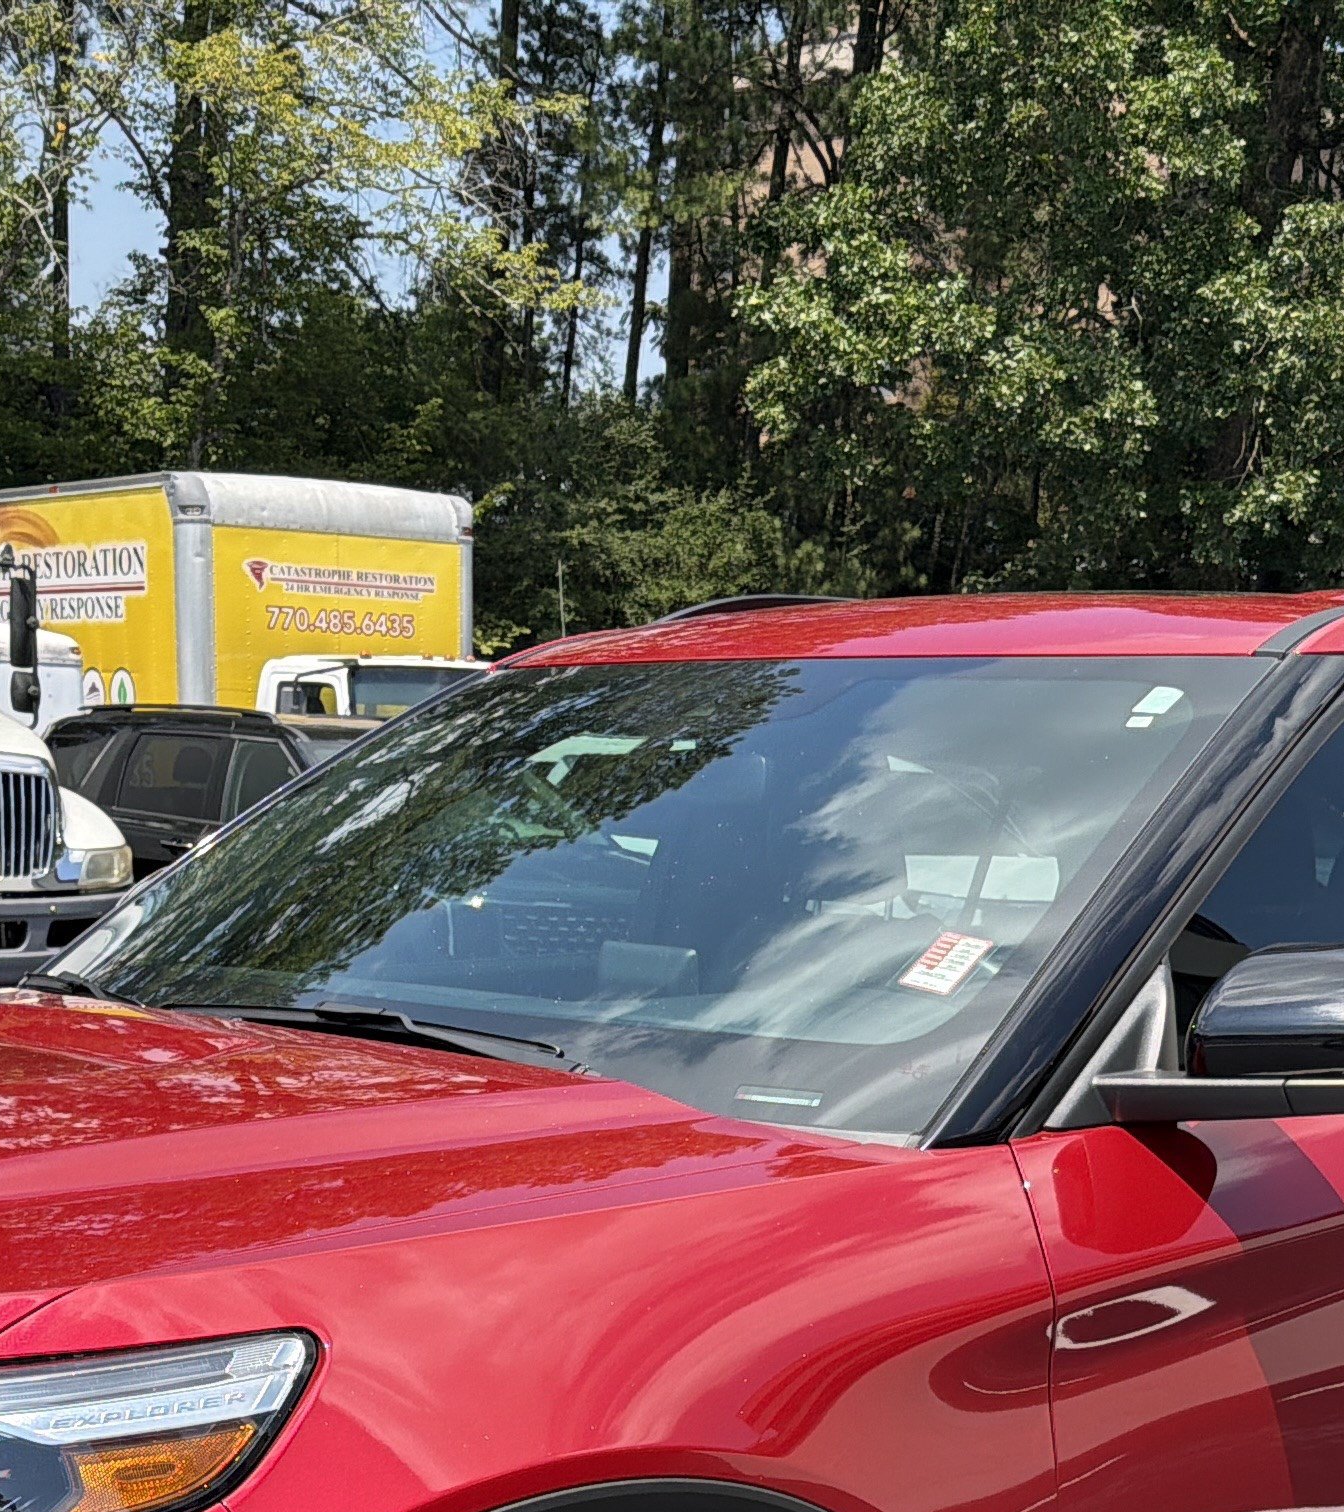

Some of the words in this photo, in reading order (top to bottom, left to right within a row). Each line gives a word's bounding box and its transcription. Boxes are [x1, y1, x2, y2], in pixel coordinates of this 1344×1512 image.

[22, 546, 145, 579] RESTORATION
[269, 565, 353, 582] CATASTROPHE
[357, 571, 435, 586] RESTORATION
[297, 583, 310, 593] HR
[313, 585, 372, 598] EMERGENCY
[374, 589, 421, 602] RESPONSE
[50, 596, 124, 620] RESPONSE
[266, 605, 415, 639] 770.485.6435
[50, 1391, 247, 1430] EXPLORER
